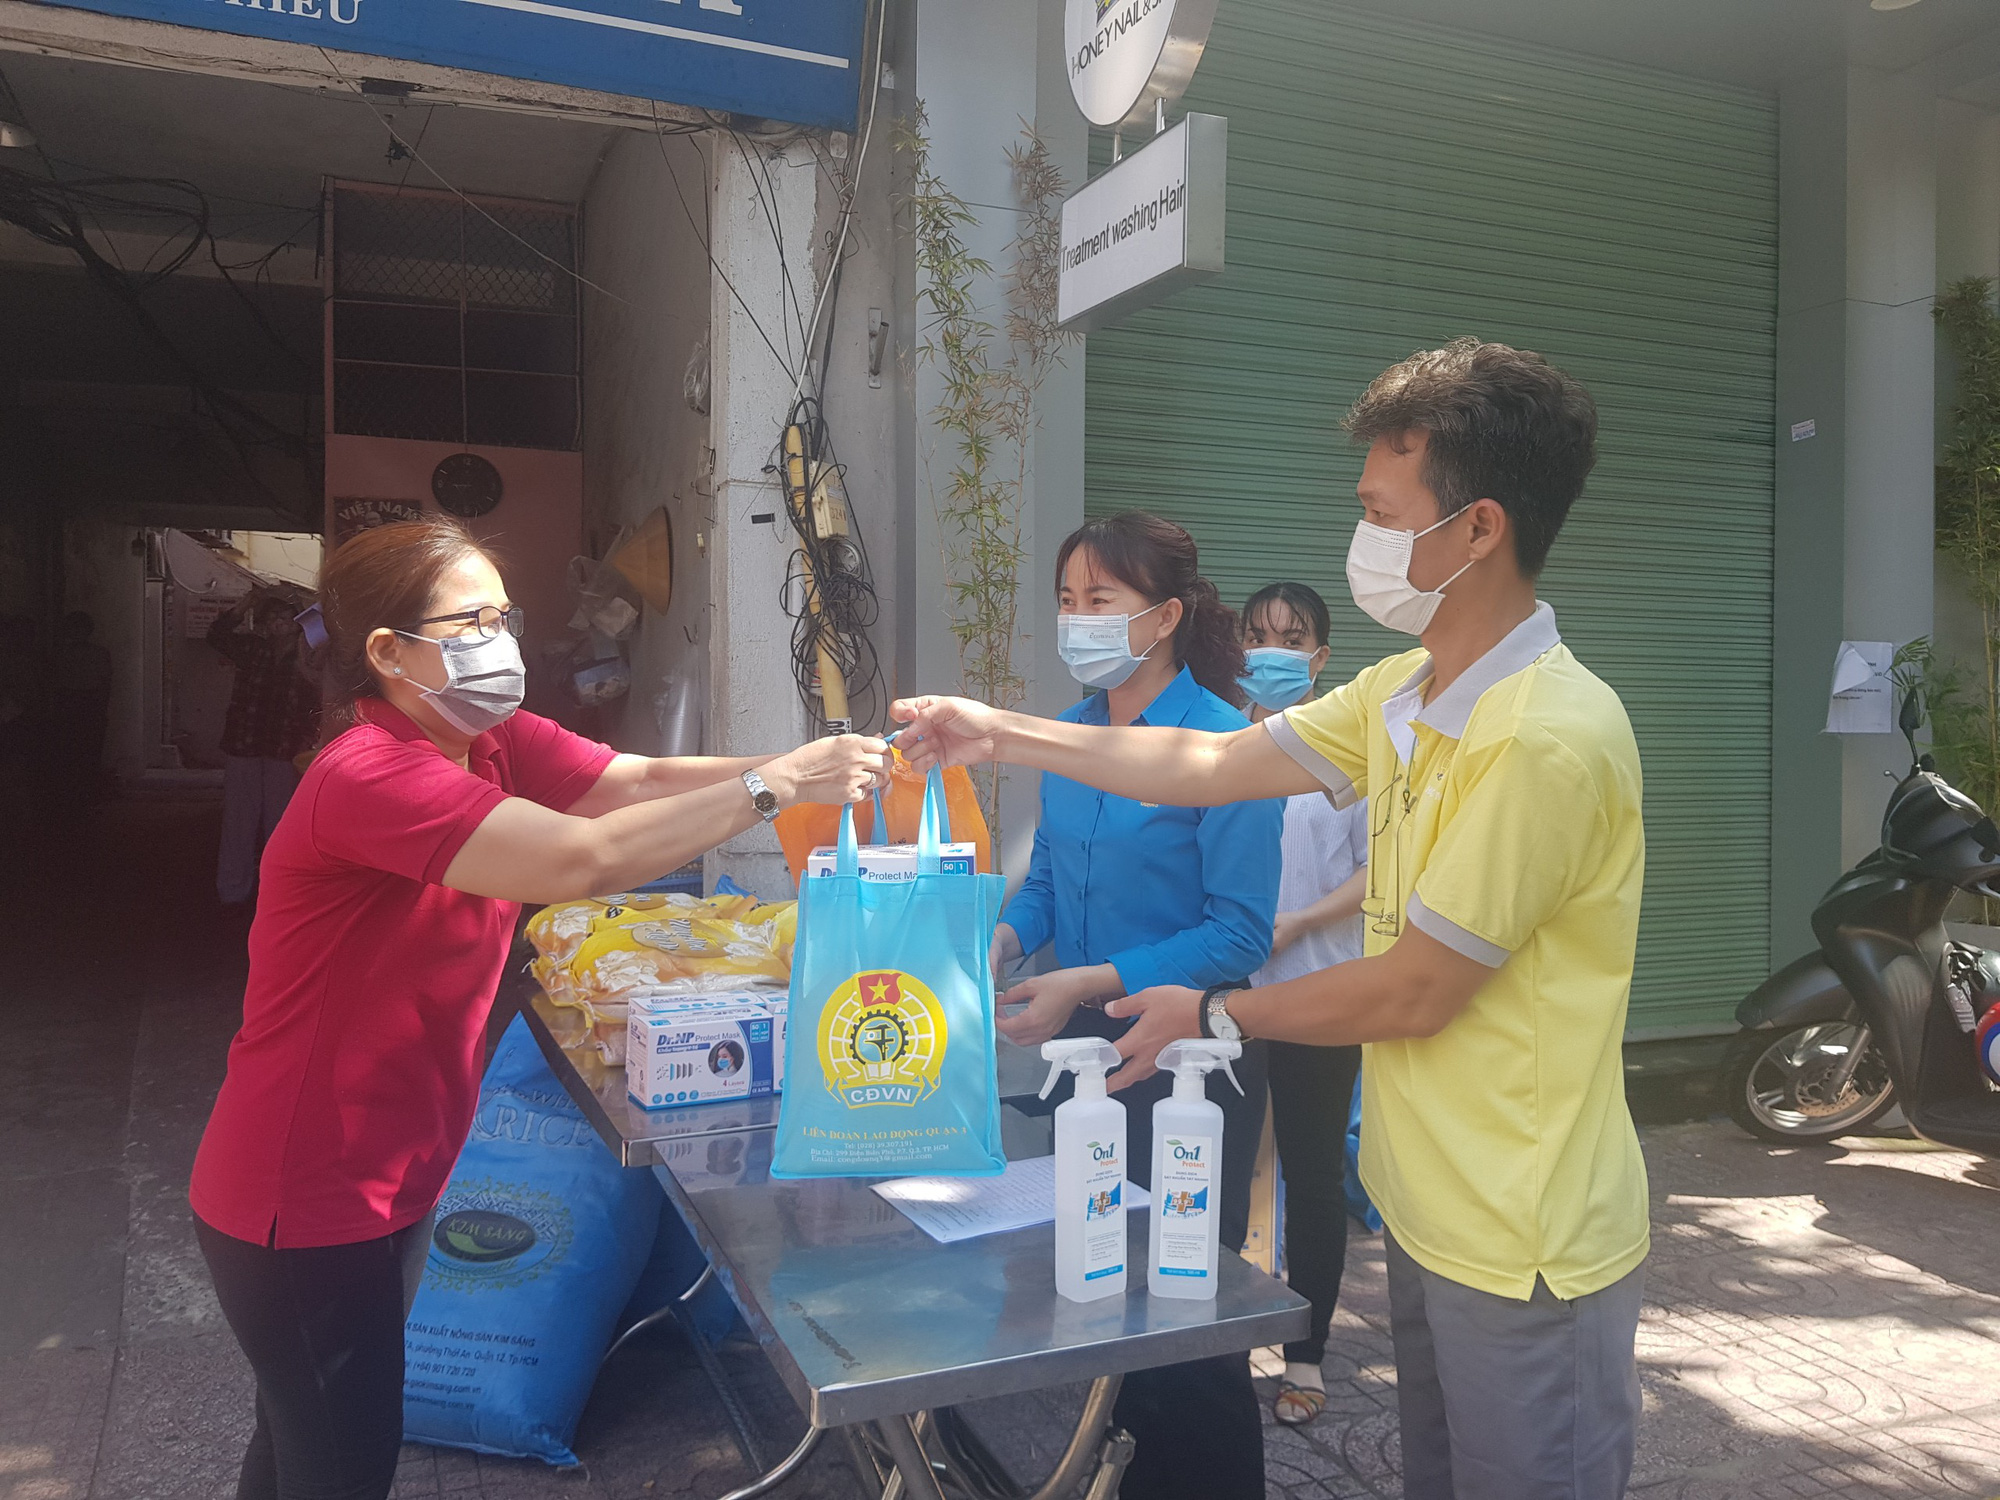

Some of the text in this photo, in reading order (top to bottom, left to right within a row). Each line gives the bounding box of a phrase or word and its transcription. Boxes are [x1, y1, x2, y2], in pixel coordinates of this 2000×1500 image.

[1071, 22, 1114, 80] HONEY
[1114, 1, 1143, 42] NAIL
[1060, 178, 1186, 273] Treatment washing Hair
[943, 863, 954, 871] 50
[868, 871, 902, 881] Protect
[903, 871, 918, 880] Ma
[656, 1032, 695, 1046] Dr.NP
[695, 1033, 721, 1043] Protect
[722, 1031, 741, 1040] Mask
[723, 1079, 728, 1087] 4
[851, 1087, 912, 1103] CĐVN
[486, 1104, 594, 1147] RICE
[863, 1130, 887, 1140] LAO
[1093, 1142, 1115, 1161] On1
[1174, 1145, 1201, 1161] On1
[1100, 1159, 1119, 1167] Protect
[1182, 1160, 1206, 1168] Protect
